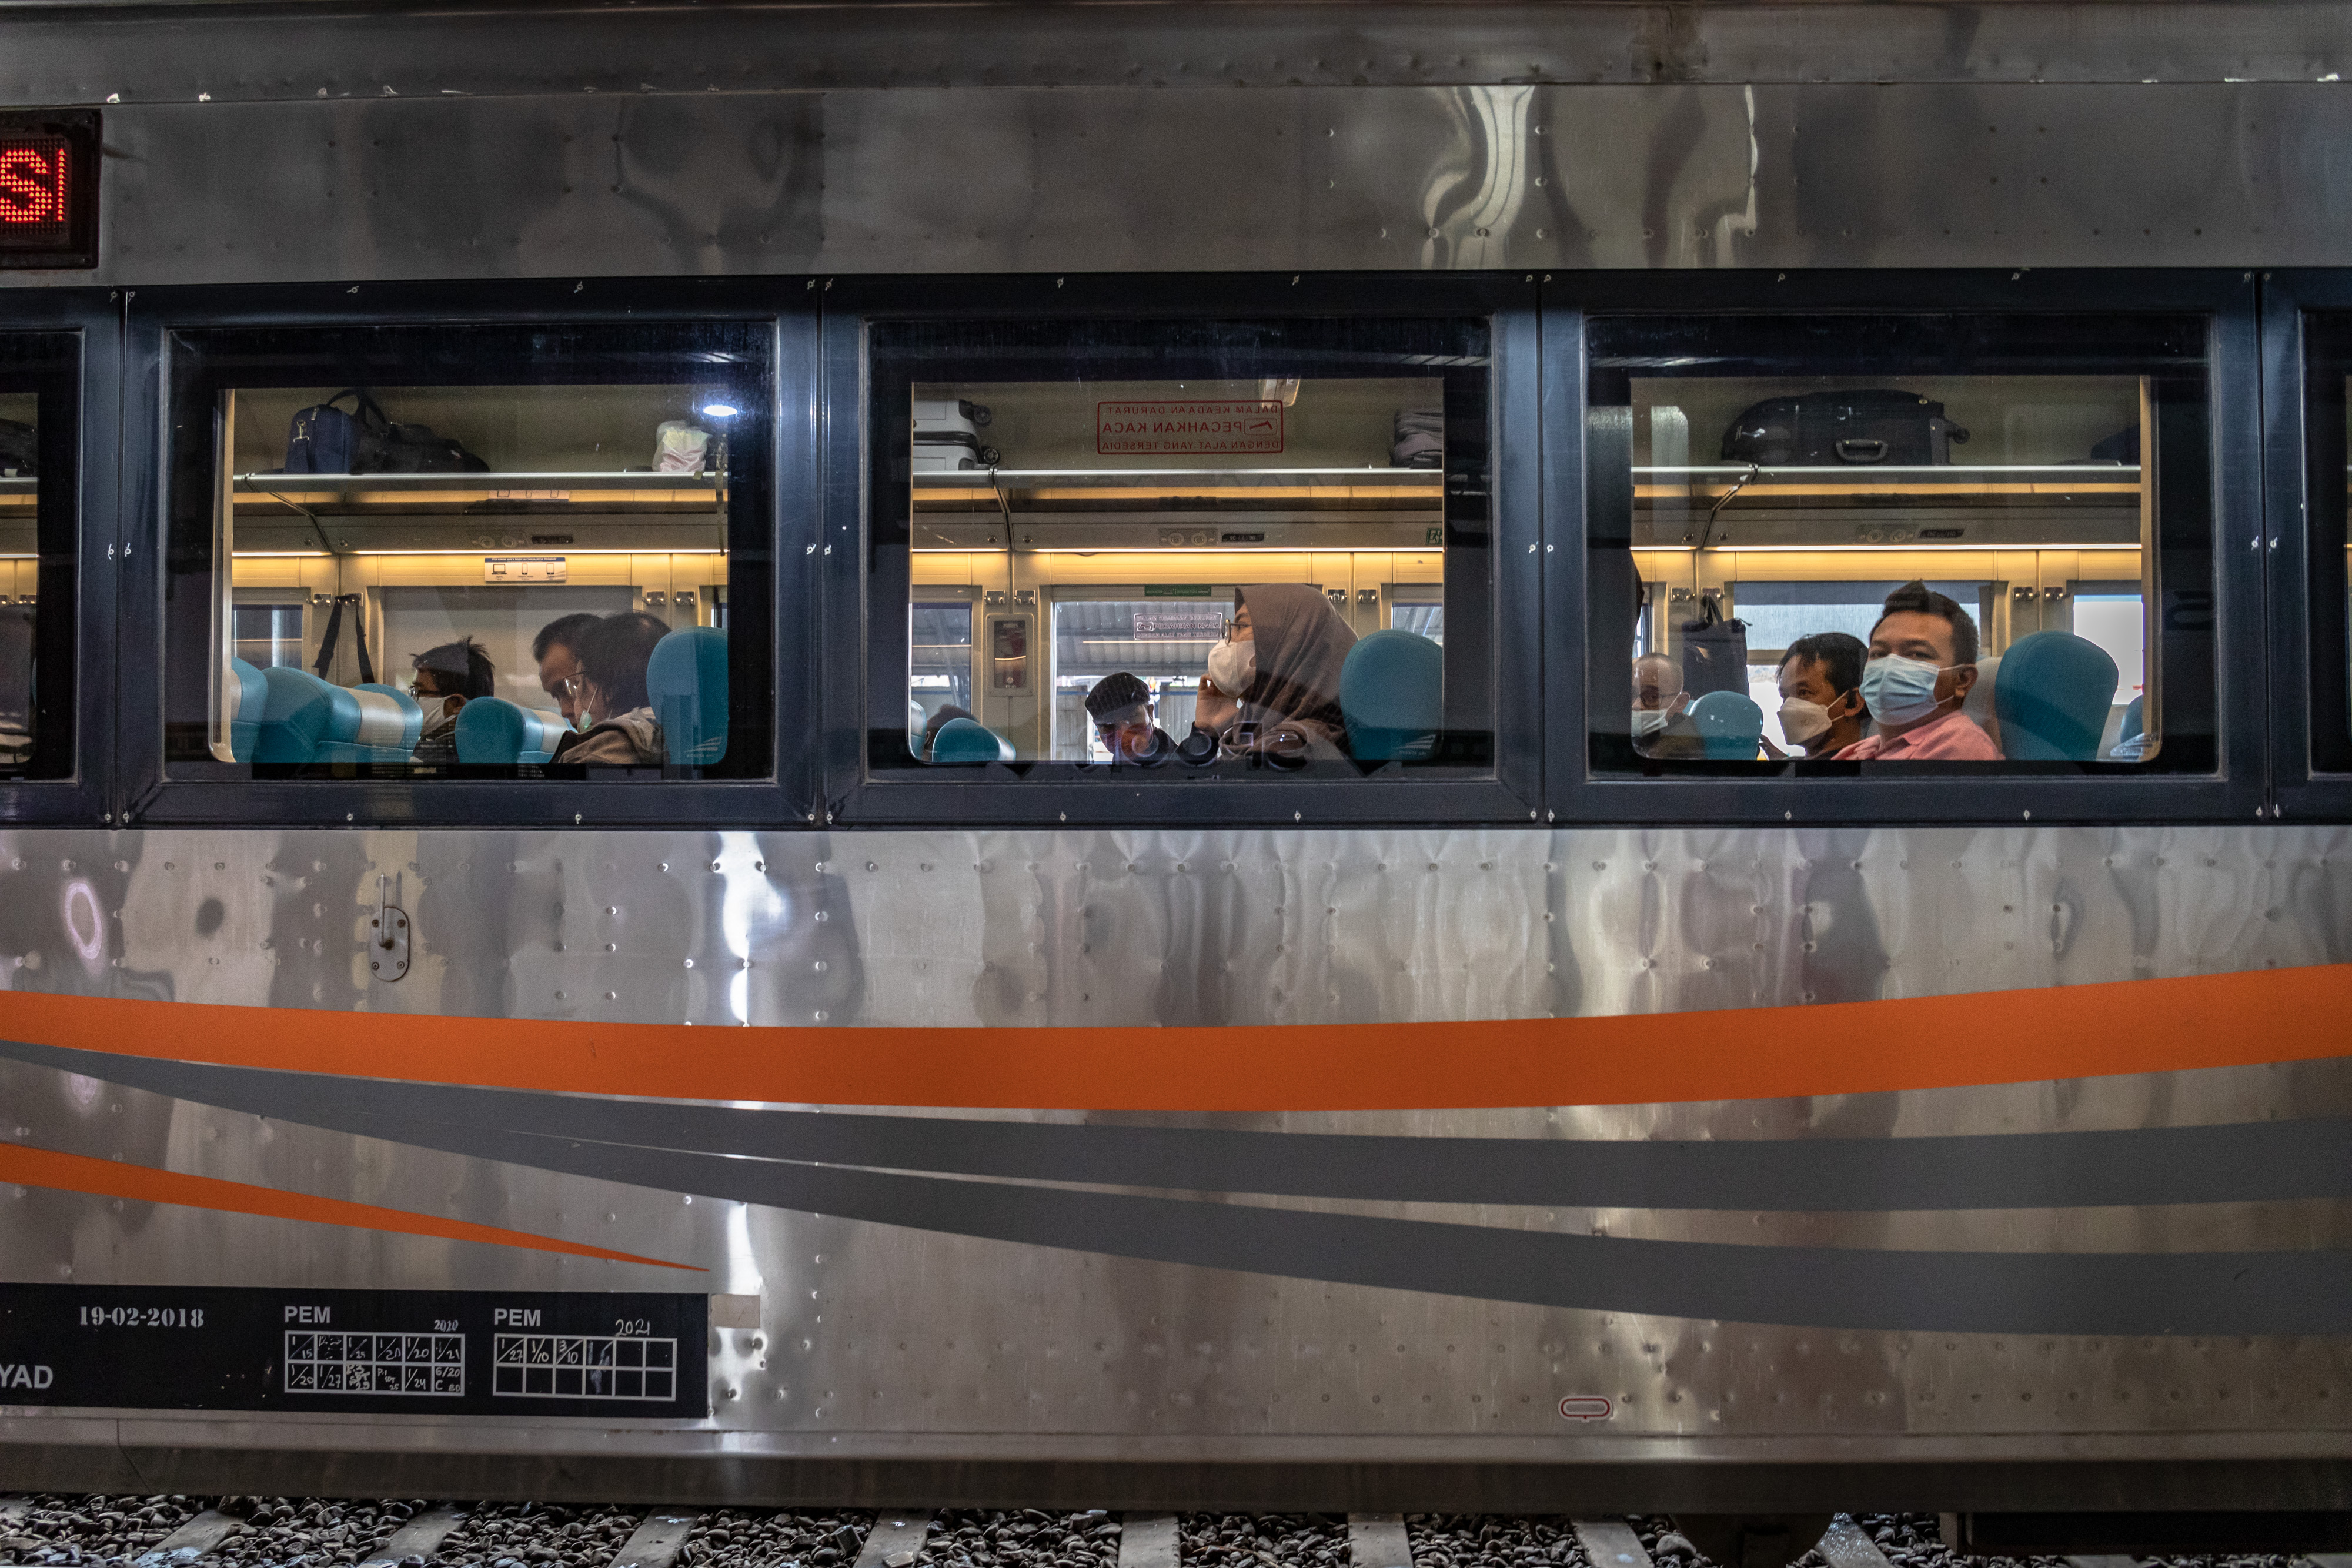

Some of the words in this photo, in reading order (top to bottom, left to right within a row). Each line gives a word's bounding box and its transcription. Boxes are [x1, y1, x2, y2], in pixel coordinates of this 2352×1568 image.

[79, 1306, 204, 1328] 19-02-2018
[284, 1306, 331, 1324] PEM
[494, 1308, 541, 1327] PEM
[434, 1319, 459, 1332] 2020
[614, 1318, 650, 1336] 2021
[0, 1364, 54, 1389] YAD
